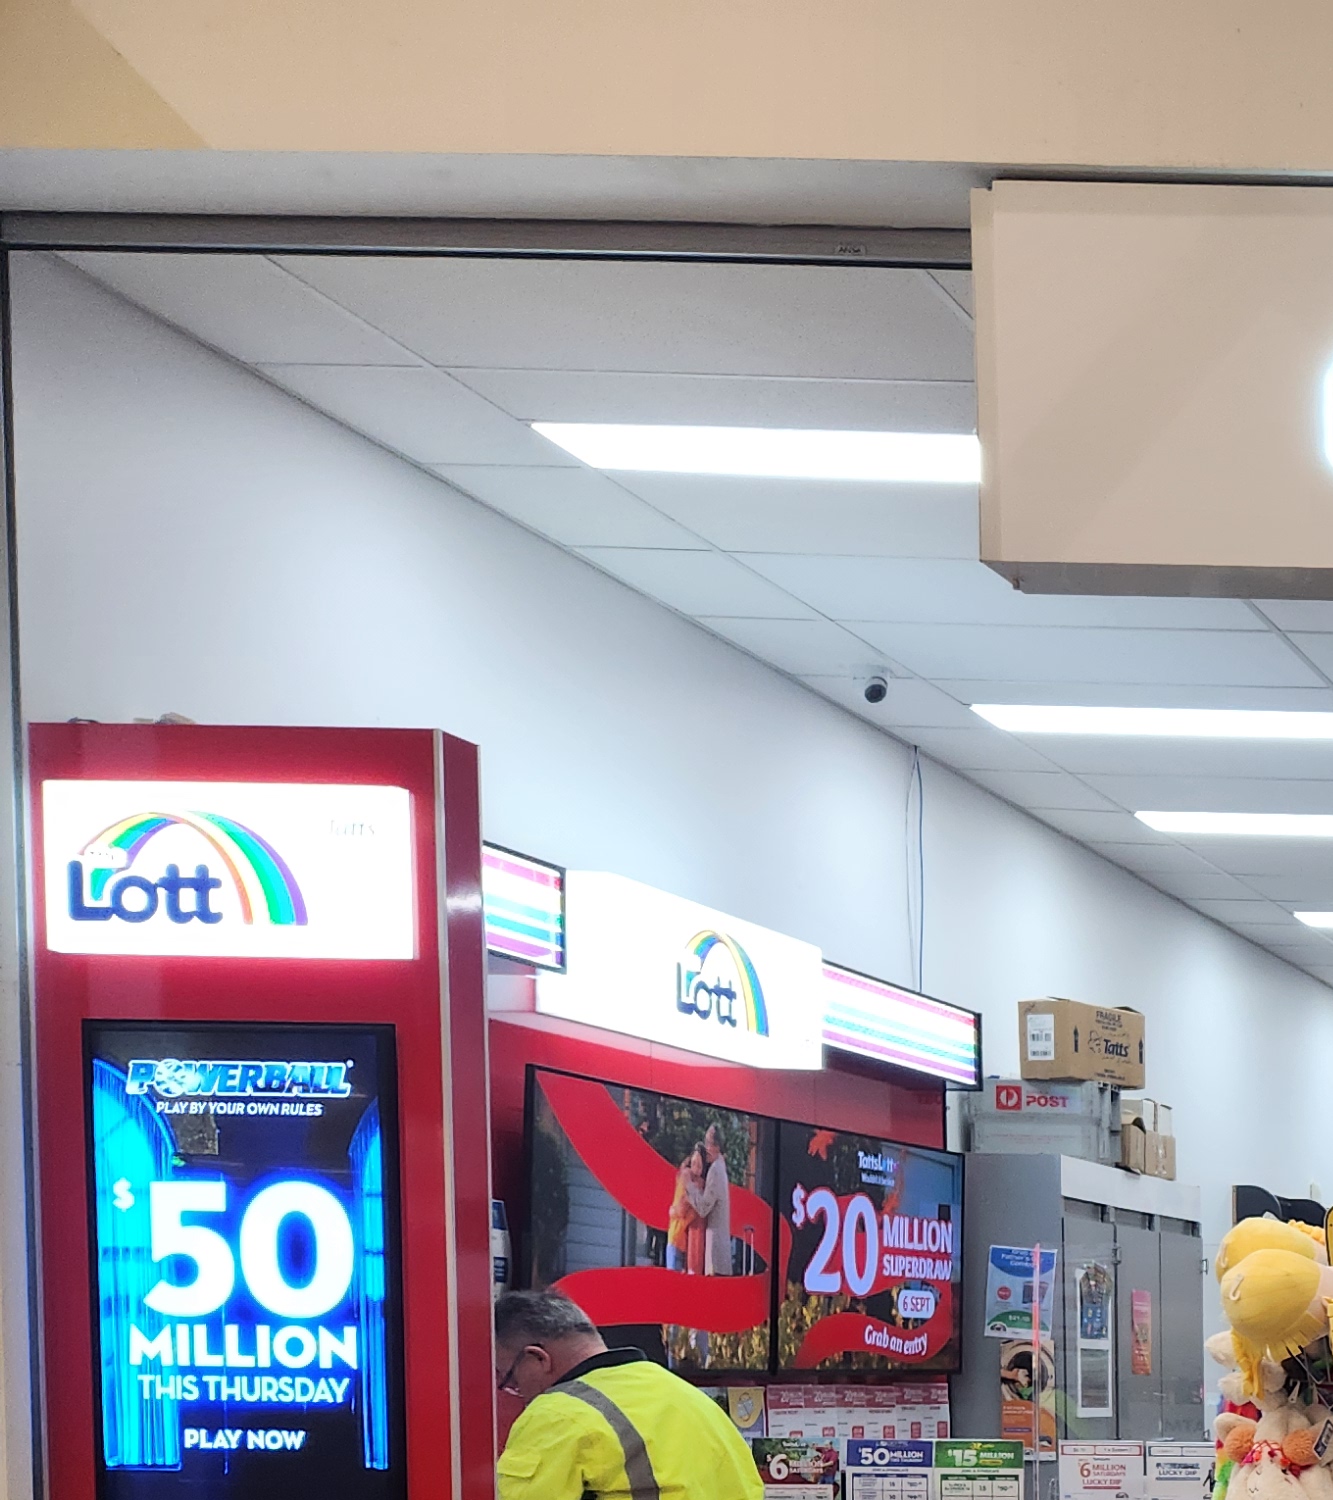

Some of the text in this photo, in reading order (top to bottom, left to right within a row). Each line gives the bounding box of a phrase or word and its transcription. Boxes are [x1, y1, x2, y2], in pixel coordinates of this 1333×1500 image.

[67, 860, 223, 924] Lott
[675, 960, 738, 1028] Lott
[1103, 1038, 1129, 1057] Tatts
[126, 1059, 351, 1097] POWERBALL
[155, 1101, 323, 1117] PLAY BY YOUR OWN RULES
[1025, 1096, 1069, 1108] POST
[882, 1213, 953, 1254] MILLION
[882, 1253, 953, 1281] SUPERDRAW
[903, 1295, 931, 1313] 6 SEPT
[129, 1323, 359, 1370] MILLION
[864, 1324, 928, 1356] Grab an entry
[137, 1374, 351, 1405] THIS THURSDAY
[184, 1428, 307, 1451] PLAY NOW
[1092, 1463, 1127, 1471] MILLION
